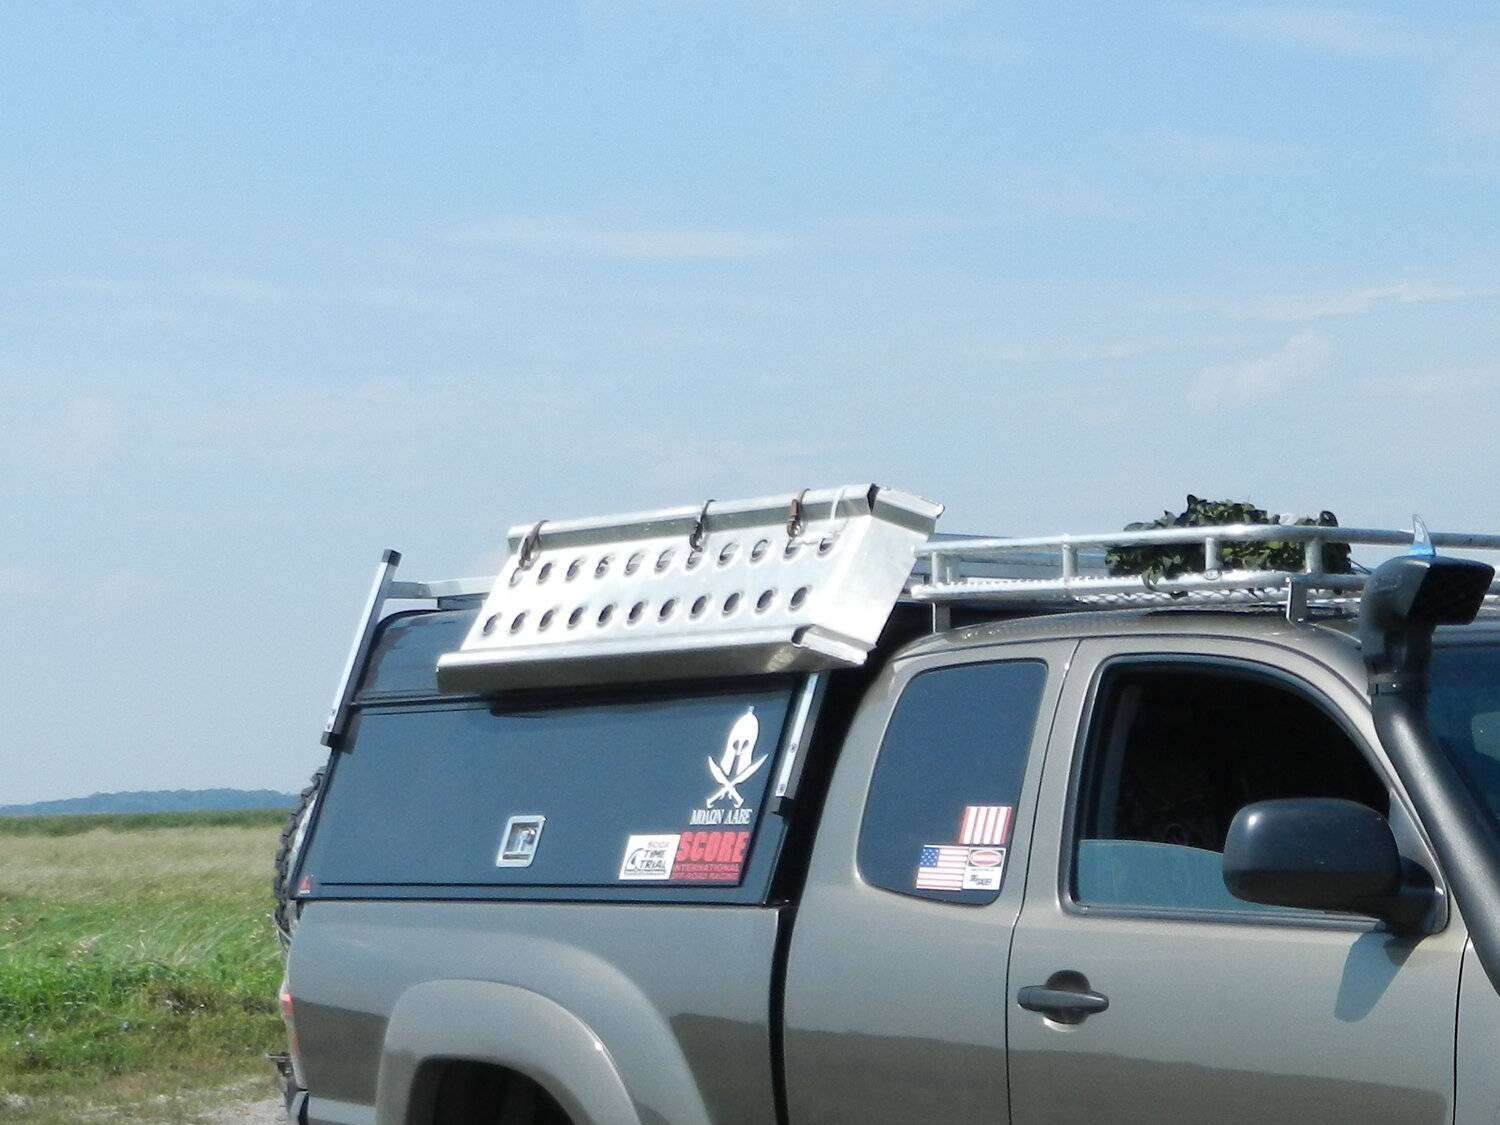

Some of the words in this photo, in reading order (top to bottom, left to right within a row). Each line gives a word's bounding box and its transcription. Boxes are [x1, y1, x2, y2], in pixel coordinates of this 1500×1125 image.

[676, 831, 751, 863] SCORE
[644, 849, 666, 858] TIME
[639, 859, 666, 869] TRIAL
